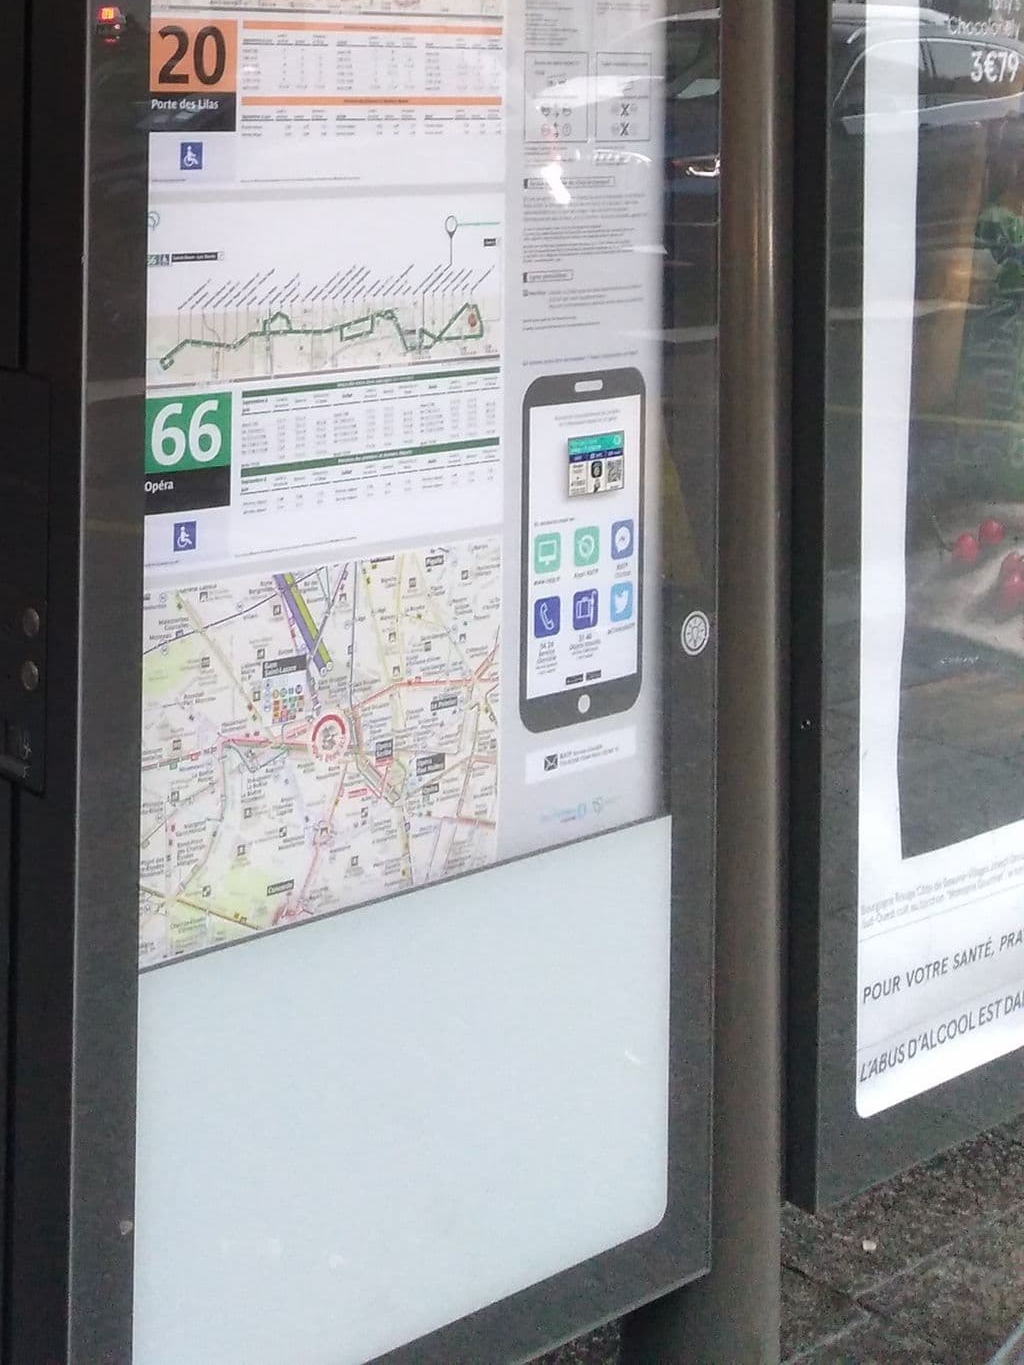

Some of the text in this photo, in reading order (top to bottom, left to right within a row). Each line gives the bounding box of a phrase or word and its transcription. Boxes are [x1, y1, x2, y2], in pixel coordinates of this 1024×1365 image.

[158, 25, 226, 85] 20
[970, 51, 1019, 83] 3€79
[151, 98, 219, 110] Porte des Lilas
[151, 399, 222, 466] 66
[144, 480, 174, 494] Opéra
[863, 975, 901, 1004] POUR
[906, 957, 949, 989] VOTRE
[952, 936, 995, 970] SANTÉ,
[859, 989, 1024, 1083] L'ABUS D'ALCOOL EST DA
